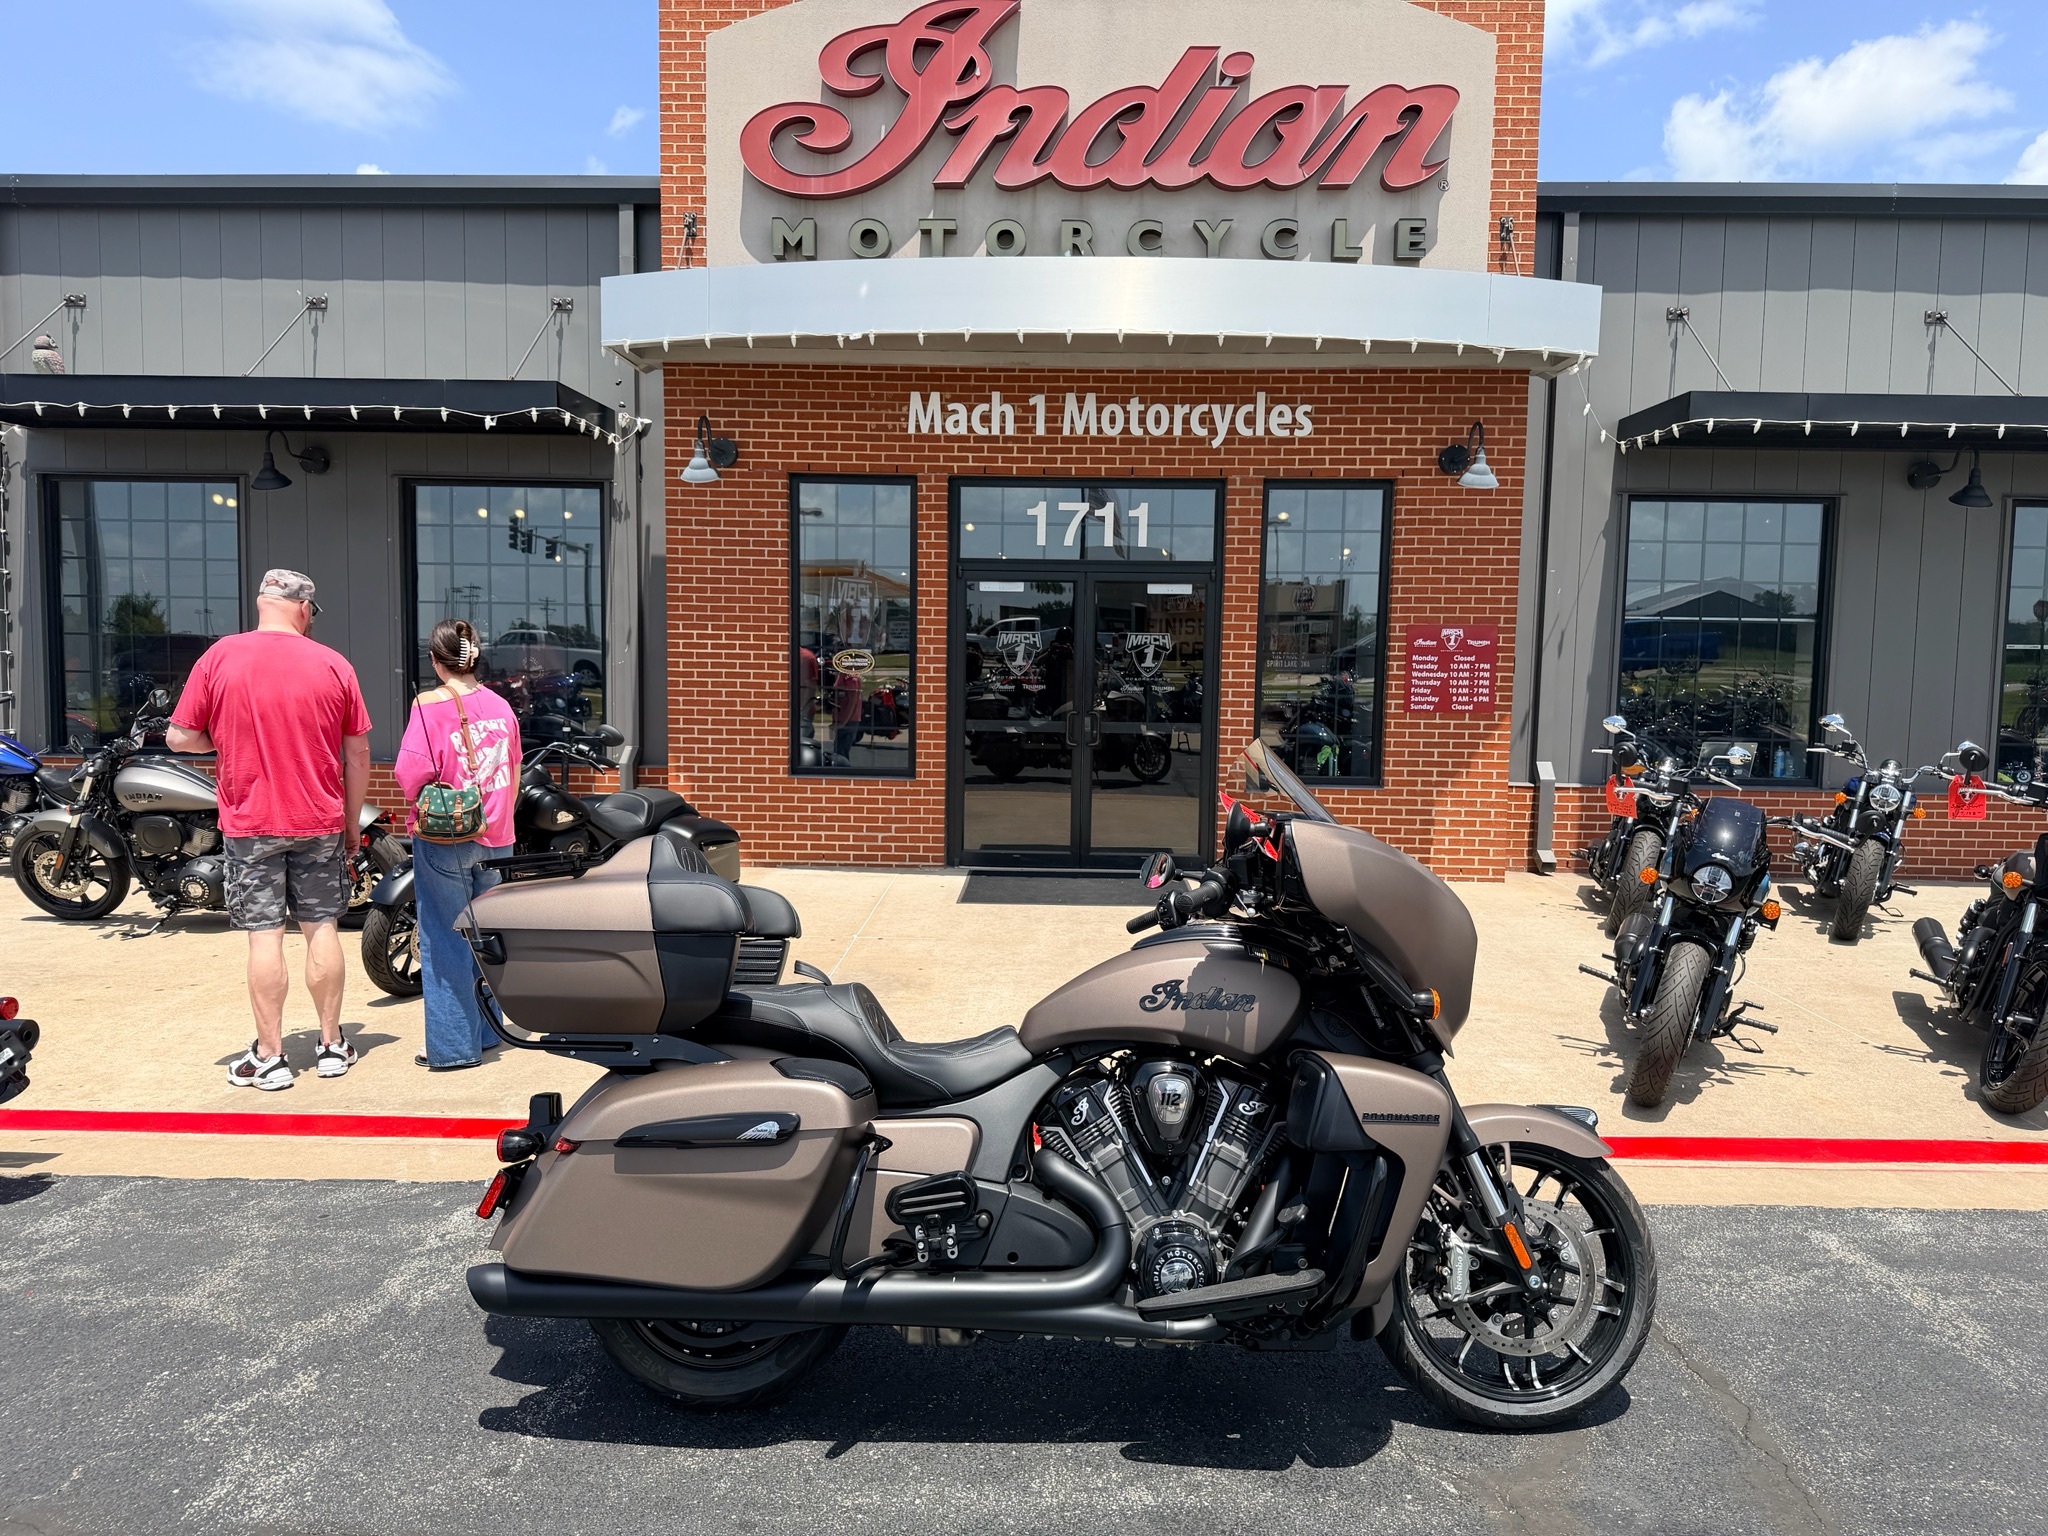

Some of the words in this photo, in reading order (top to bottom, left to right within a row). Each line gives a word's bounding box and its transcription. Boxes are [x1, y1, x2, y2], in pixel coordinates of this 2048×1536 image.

[740, 0, 1460, 199] Indian
[771, 217, 1428, 260] MOTORCYCLE
[907, 391, 1015, 436] Mach
[1028, 394, 1046, 436] 1
[1062, 391, 1313, 449] Motorcycles
[1026, 501, 1149, 548] 1711
[998, 633, 1040, 648] MACH
[1011, 642, 1027, 666] 1
[1128, 634, 1170, 649] MACH
[1141, 644, 1156, 668] 1
[1139, 979, 1256, 1012] Indian
[1160, 1092, 1182, 1106] 112
[1362, 1113, 1440, 1122] ROADMASTER
[1166, 1250, 1204, 1288] MOTORCYC
[1454, 1256, 1463, 1290] brembo
[607, 1320, 666, 1377] METZEL
